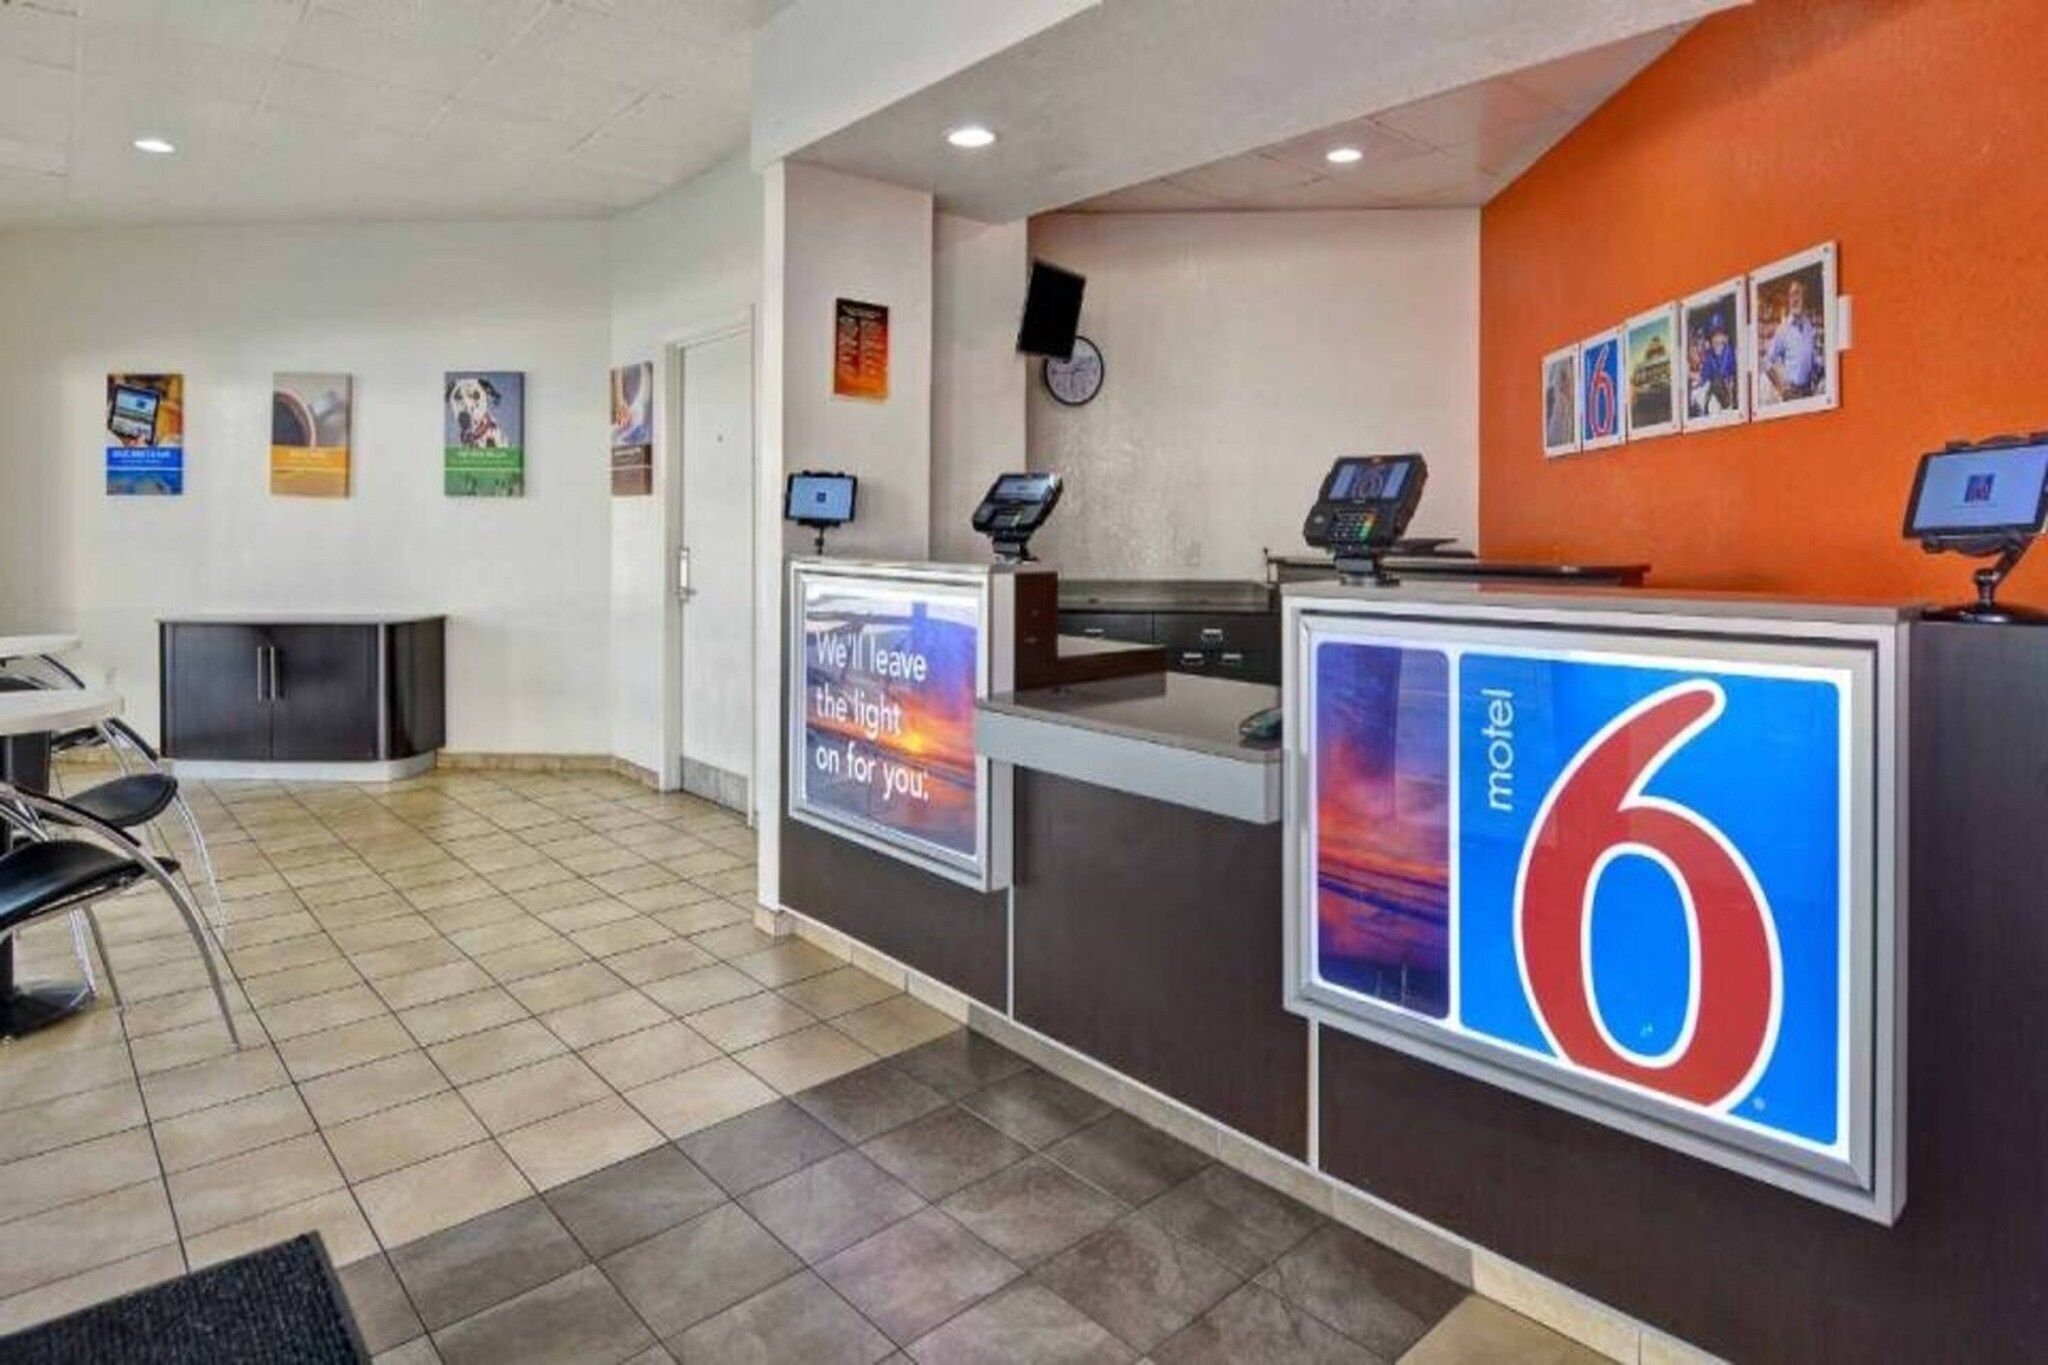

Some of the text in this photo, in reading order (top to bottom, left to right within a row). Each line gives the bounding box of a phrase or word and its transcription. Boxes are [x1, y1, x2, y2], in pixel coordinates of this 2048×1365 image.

[816, 633, 928, 681] We'll leave
[816, 683, 902, 739] the light
[816, 745, 840, 772] on
[846, 741, 877, 784] for
[1481, 687, 1514, 813] motel
[1513, 679, 1784, 1113] 6
